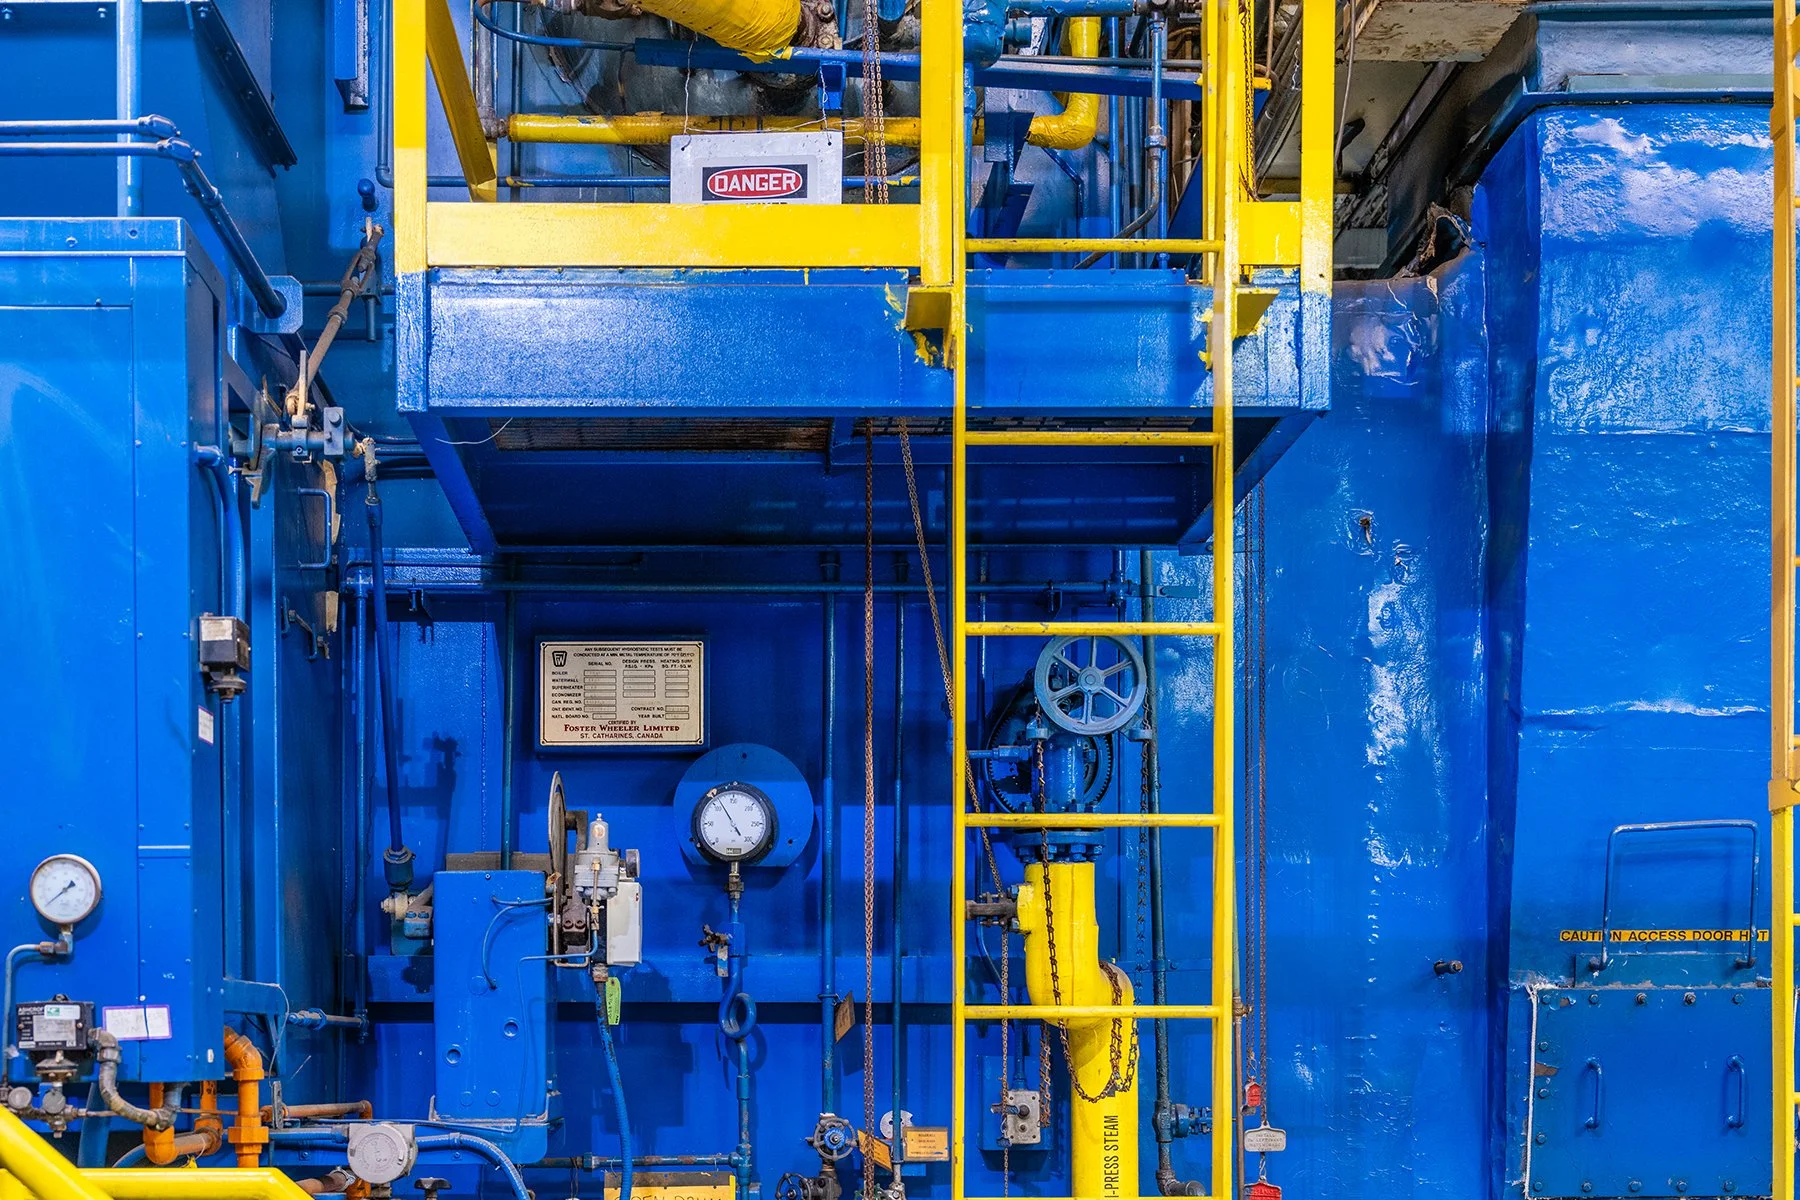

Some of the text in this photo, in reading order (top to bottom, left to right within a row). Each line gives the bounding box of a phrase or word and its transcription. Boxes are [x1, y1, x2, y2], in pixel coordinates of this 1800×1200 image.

[714, 173, 796, 193] DANGER
[564, 724, 680, 732] FOSTER WHEELER LIMITED
[1561, 930, 1768, 941] CAUTIN ACCESS DOOR HT
[1103, 1115, 1119, 1151] STEAM
